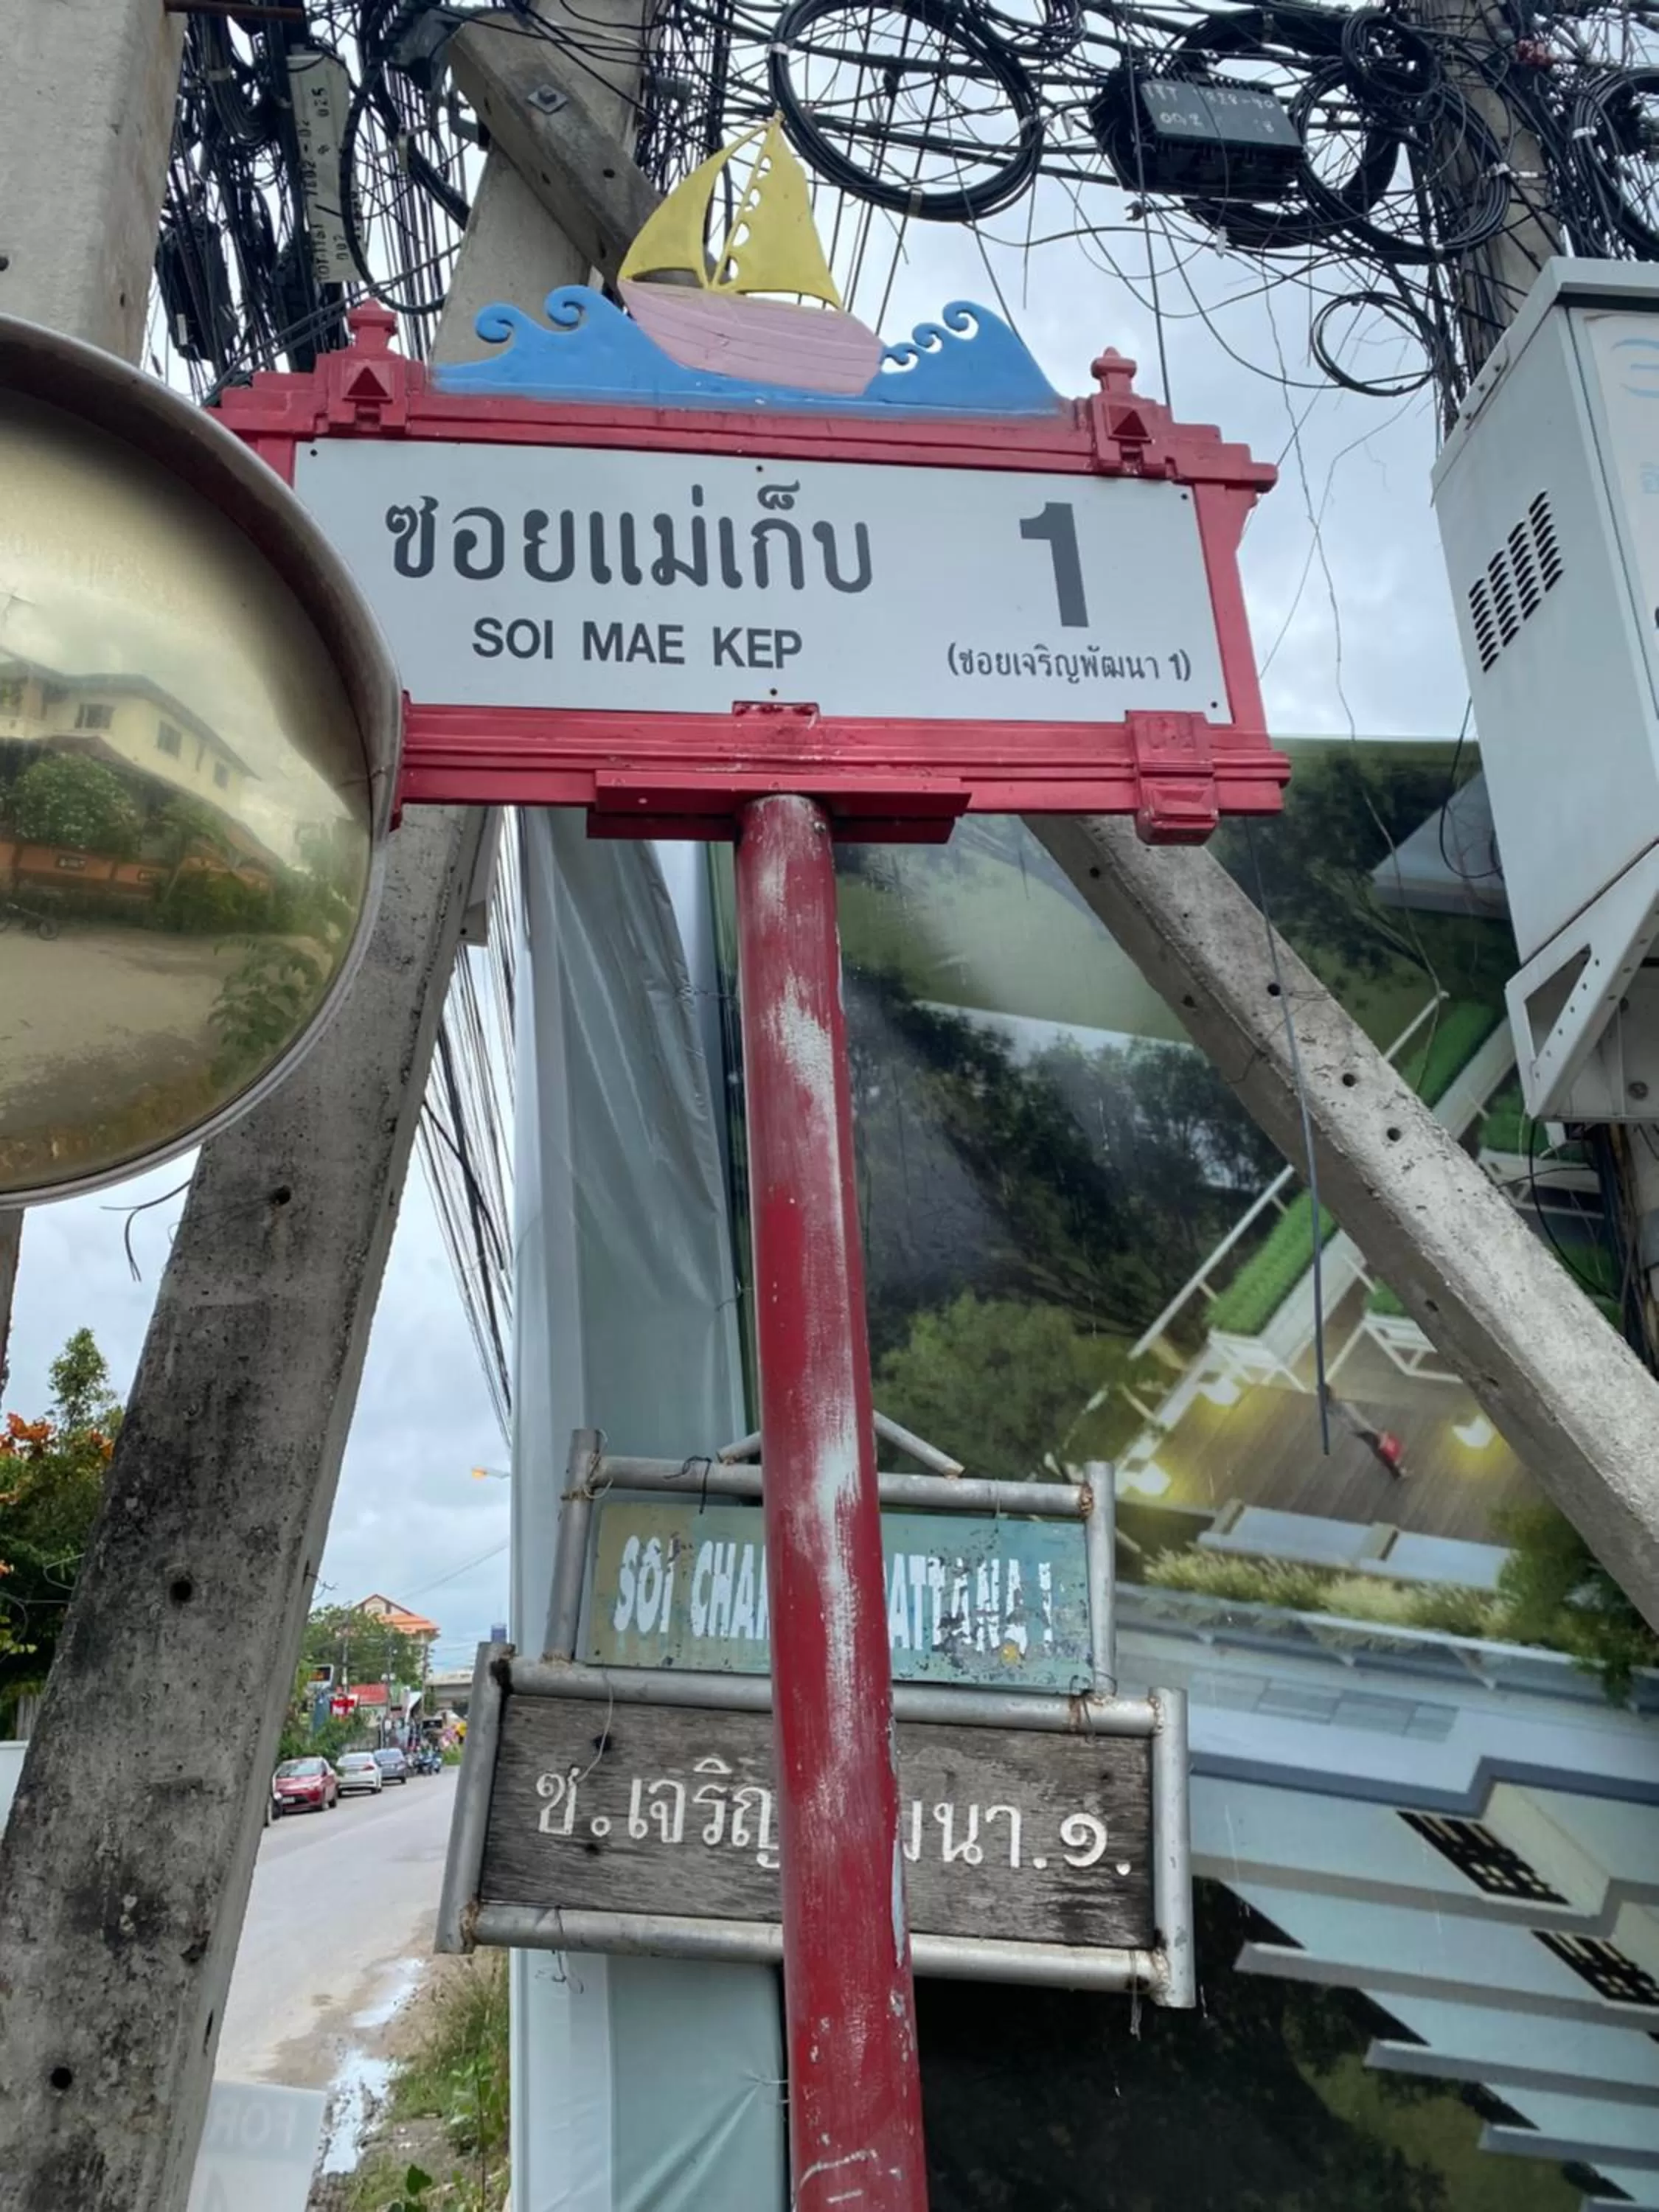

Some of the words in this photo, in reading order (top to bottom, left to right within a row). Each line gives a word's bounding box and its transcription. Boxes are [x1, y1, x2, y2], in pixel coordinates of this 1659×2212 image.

[386, 481, 873, 594] ซอยแม่เก็บ
[1020, 501, 1089, 627] 1
[473, 617, 554, 659] SOI
[582, 621, 686, 665] MAE
[712, 627, 803, 669] KEP
[613, 1534, 678, 1634] SOI
